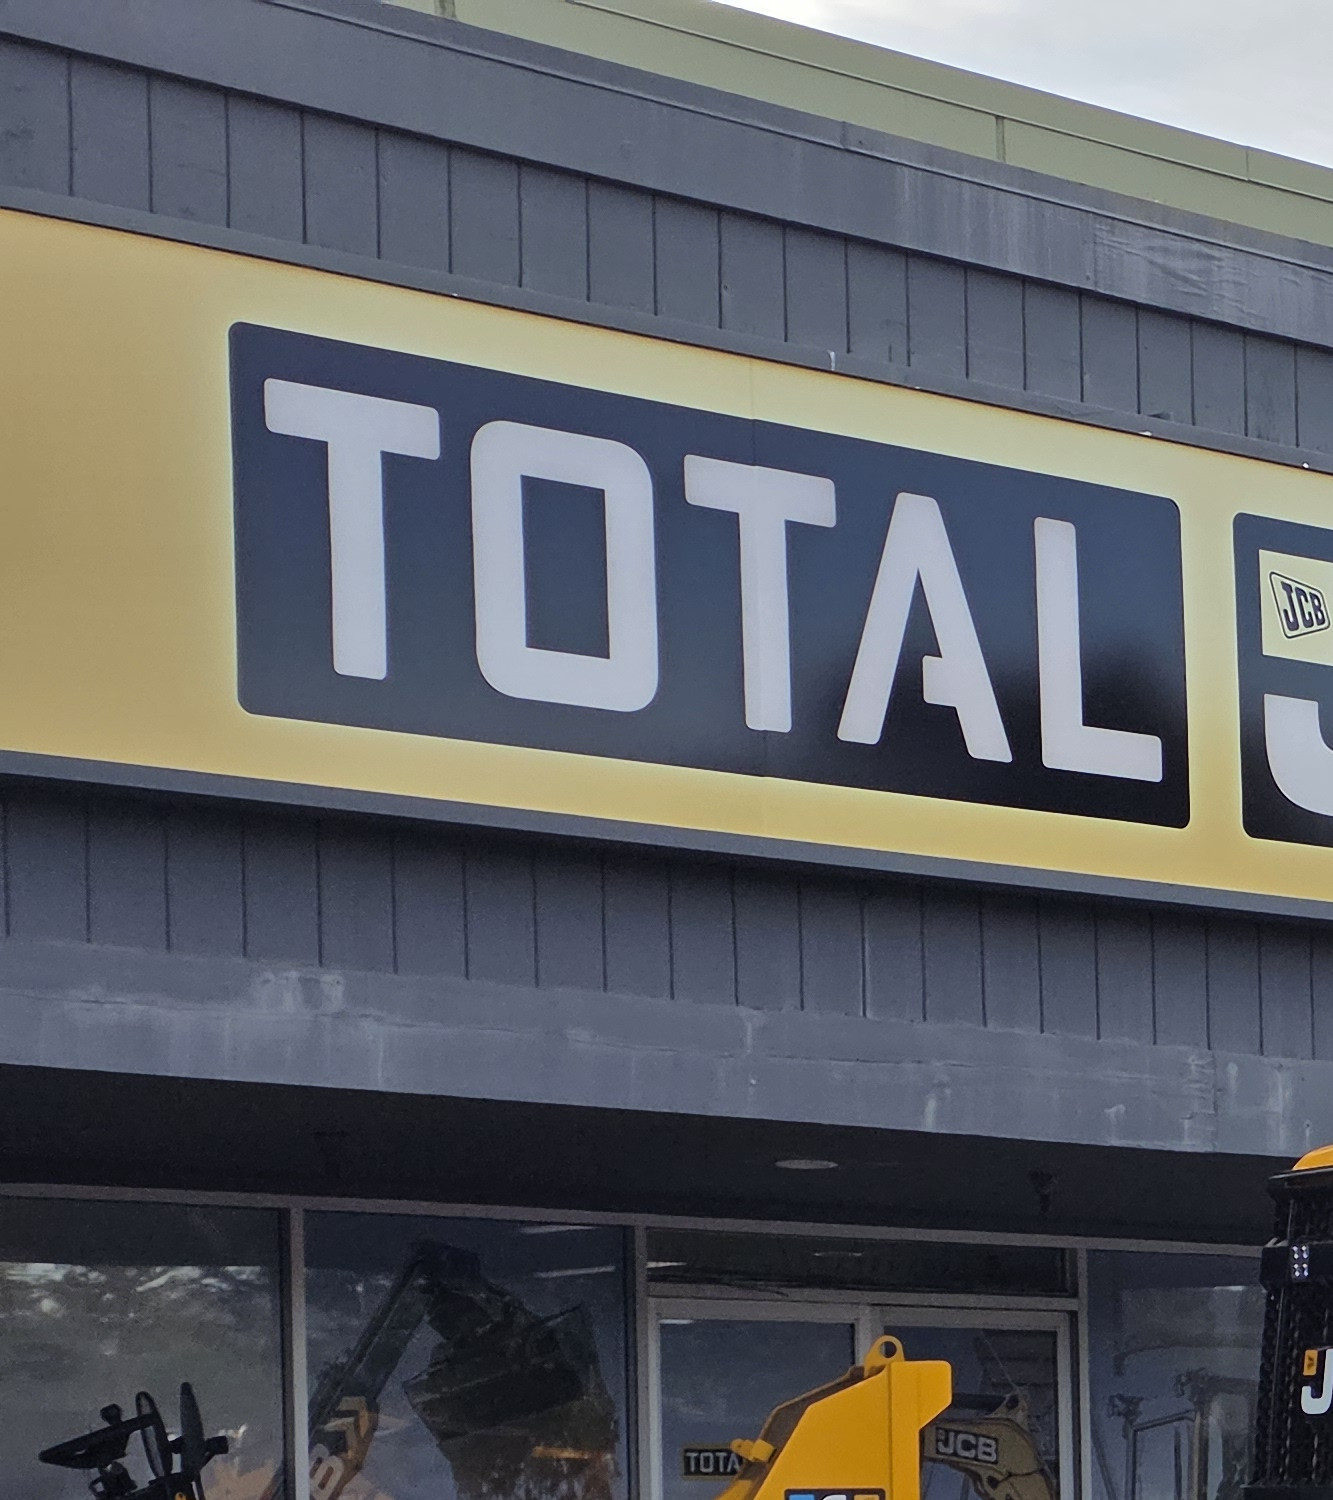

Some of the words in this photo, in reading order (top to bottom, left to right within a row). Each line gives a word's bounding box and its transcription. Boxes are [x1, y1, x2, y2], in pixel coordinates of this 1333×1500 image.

[263, 377, 1163, 783] TOTAL
[1280, 581, 1326, 632] JCB
[685, 1452, 742, 1475] TOTA
[937, 1429, 998, 1462] JCB
